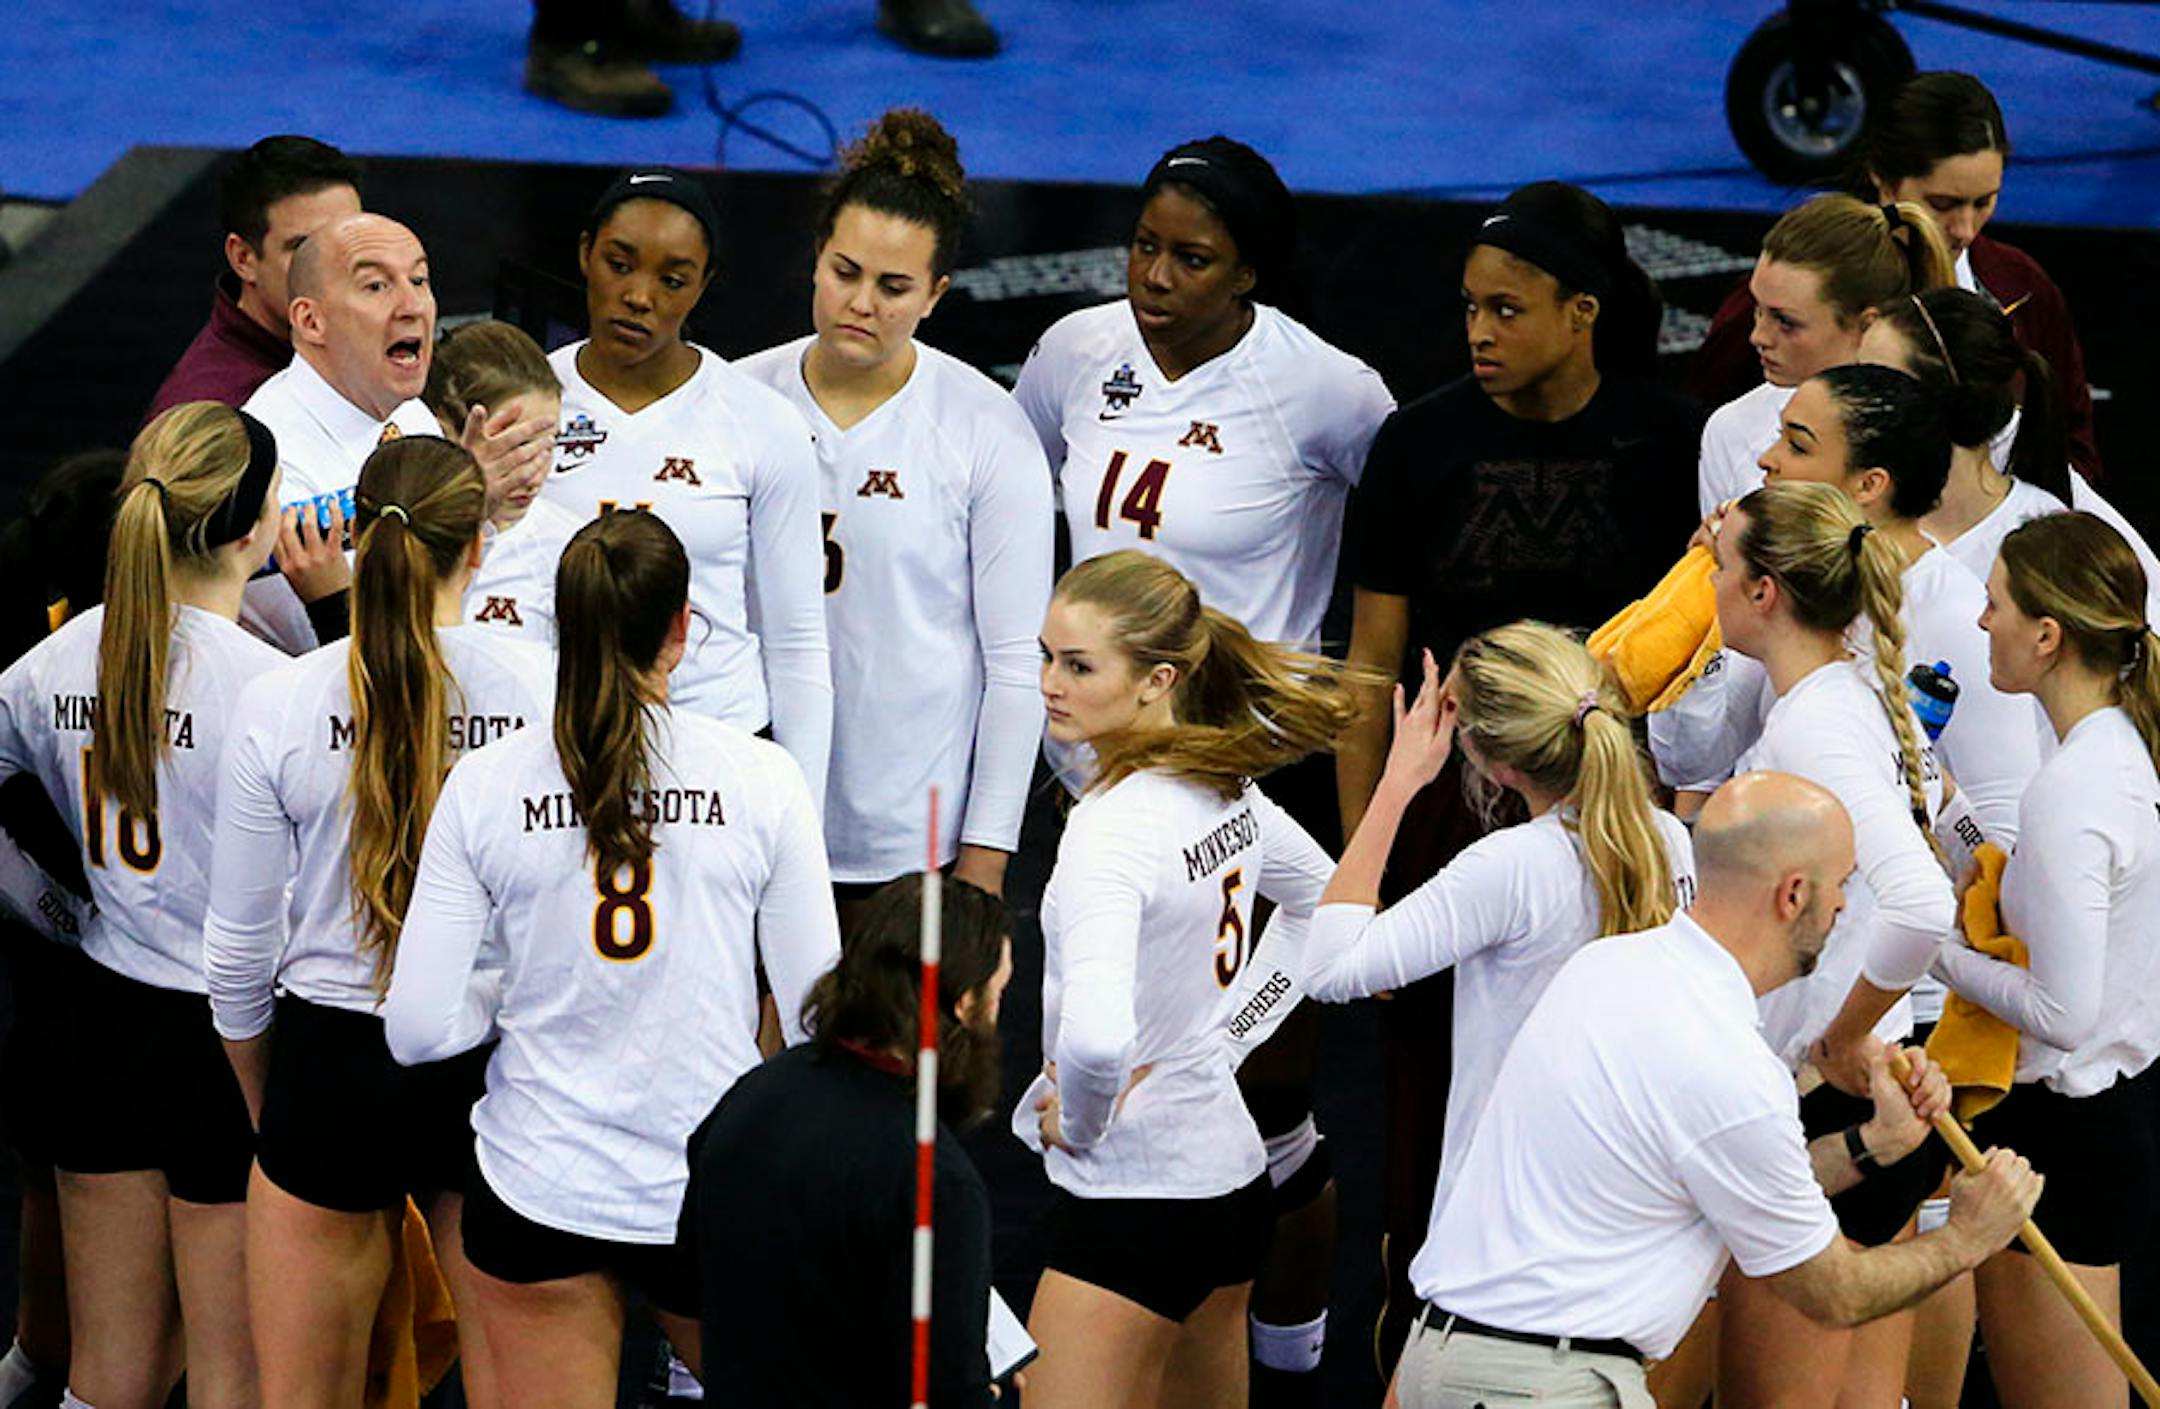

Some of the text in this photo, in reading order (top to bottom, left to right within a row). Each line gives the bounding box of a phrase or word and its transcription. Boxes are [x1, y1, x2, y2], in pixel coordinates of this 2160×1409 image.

[1095, 449, 1173, 542] 14
[53, 693, 195, 748] MINTA
[592, 848, 656, 963] 8
[1215, 866, 1245, 991] 5
[1228, 970, 1293, 1040] GOPHERS
